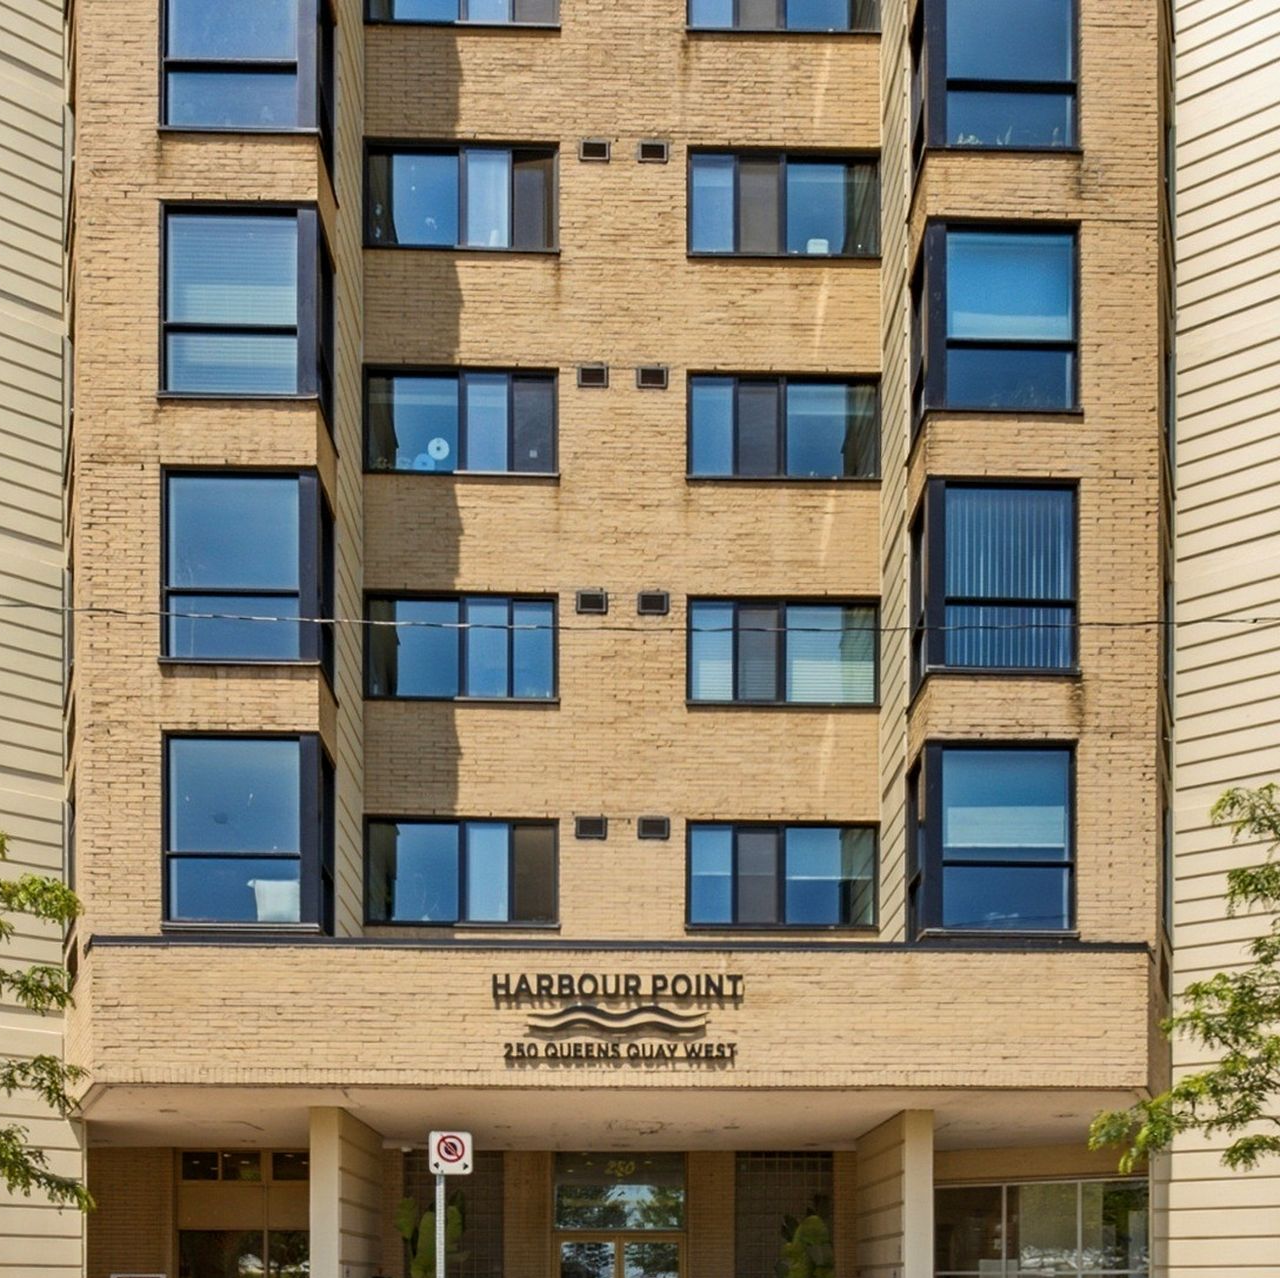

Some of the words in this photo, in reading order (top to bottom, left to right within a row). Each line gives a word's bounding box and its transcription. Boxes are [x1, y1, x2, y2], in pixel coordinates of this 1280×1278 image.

[492, 973, 642, 998] HARBOUR
[651, 973, 744, 998] POINT
[503, 1042, 539, 1060] 250
[545, 1042, 620, 1060] QUEENS
[626, 1043, 679, 1060] QUAY
[683, 1042, 738, 1060] WEST
